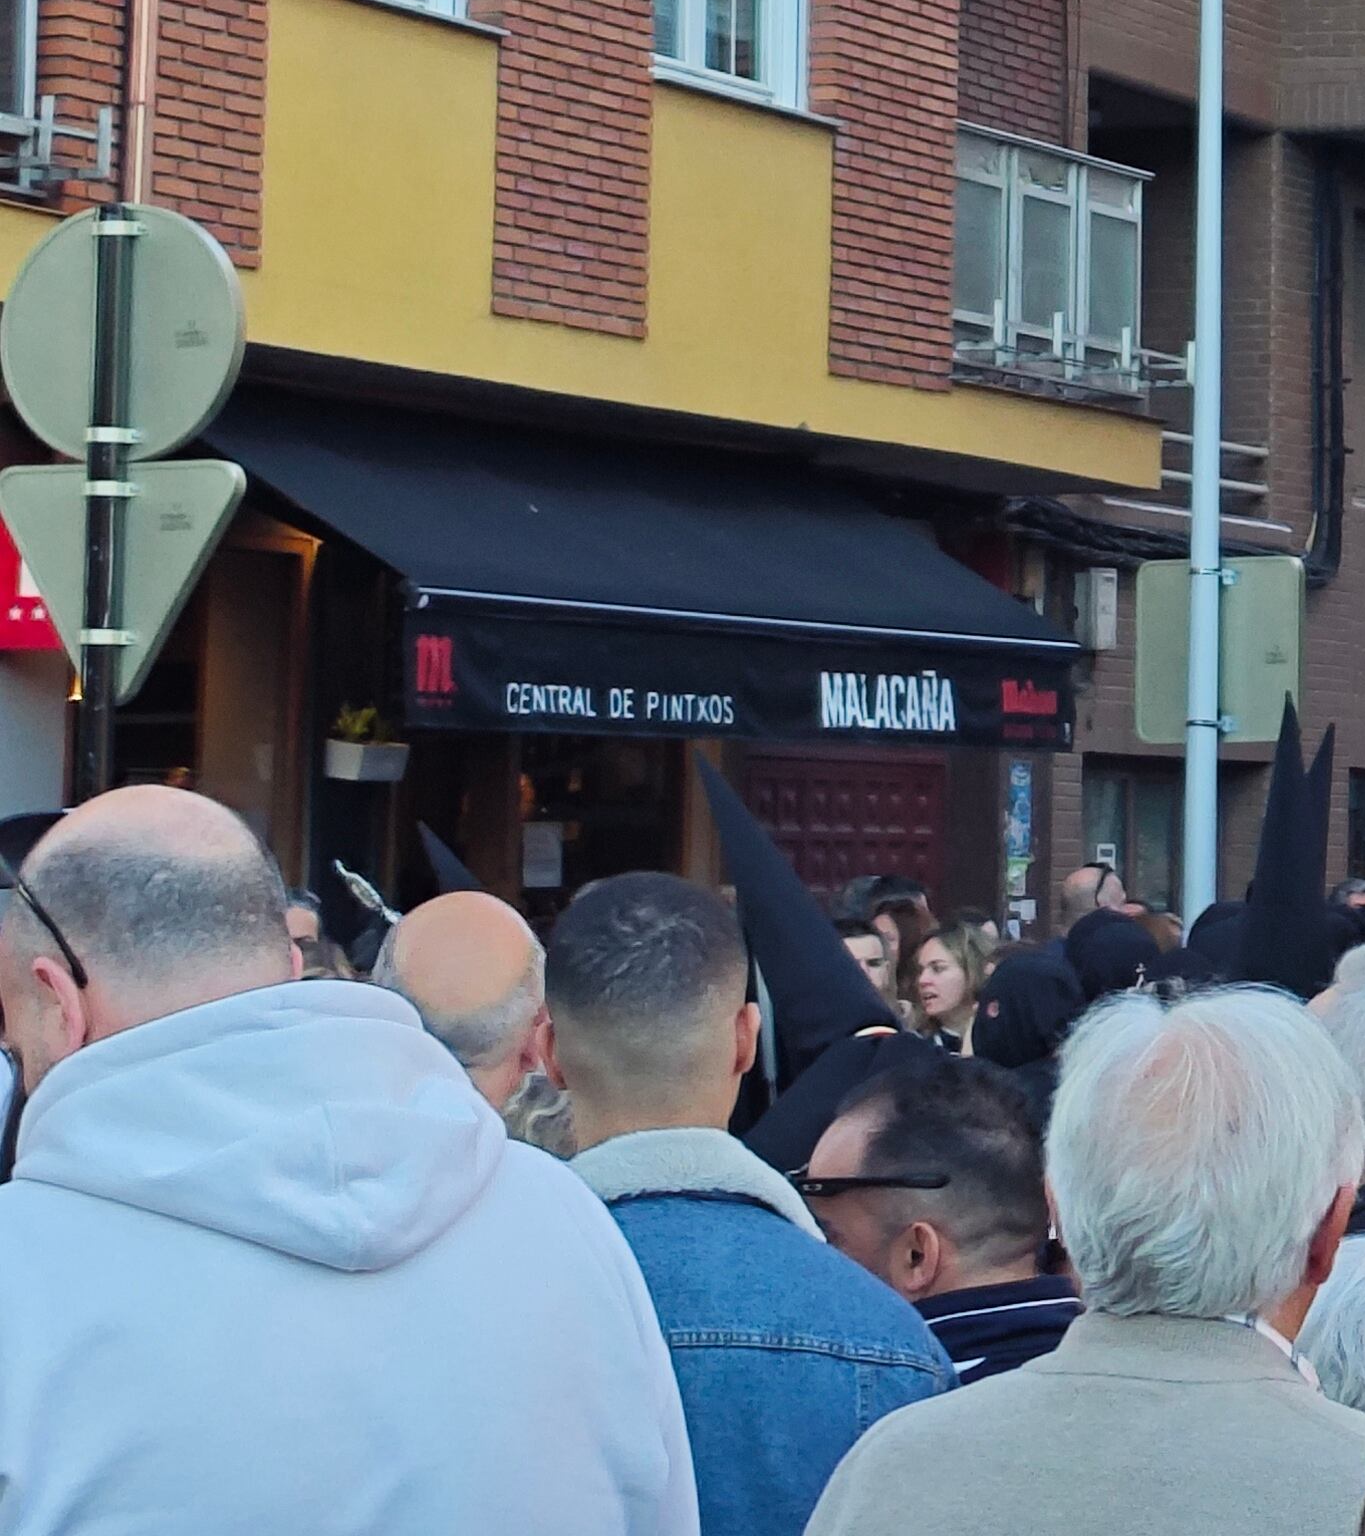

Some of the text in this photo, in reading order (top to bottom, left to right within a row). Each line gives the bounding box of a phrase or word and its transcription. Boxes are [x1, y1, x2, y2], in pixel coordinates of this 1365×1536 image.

[506, 682, 734, 724] CENTRAL DE PINTXOS
[820, 669, 956, 731] MALACAÑA
